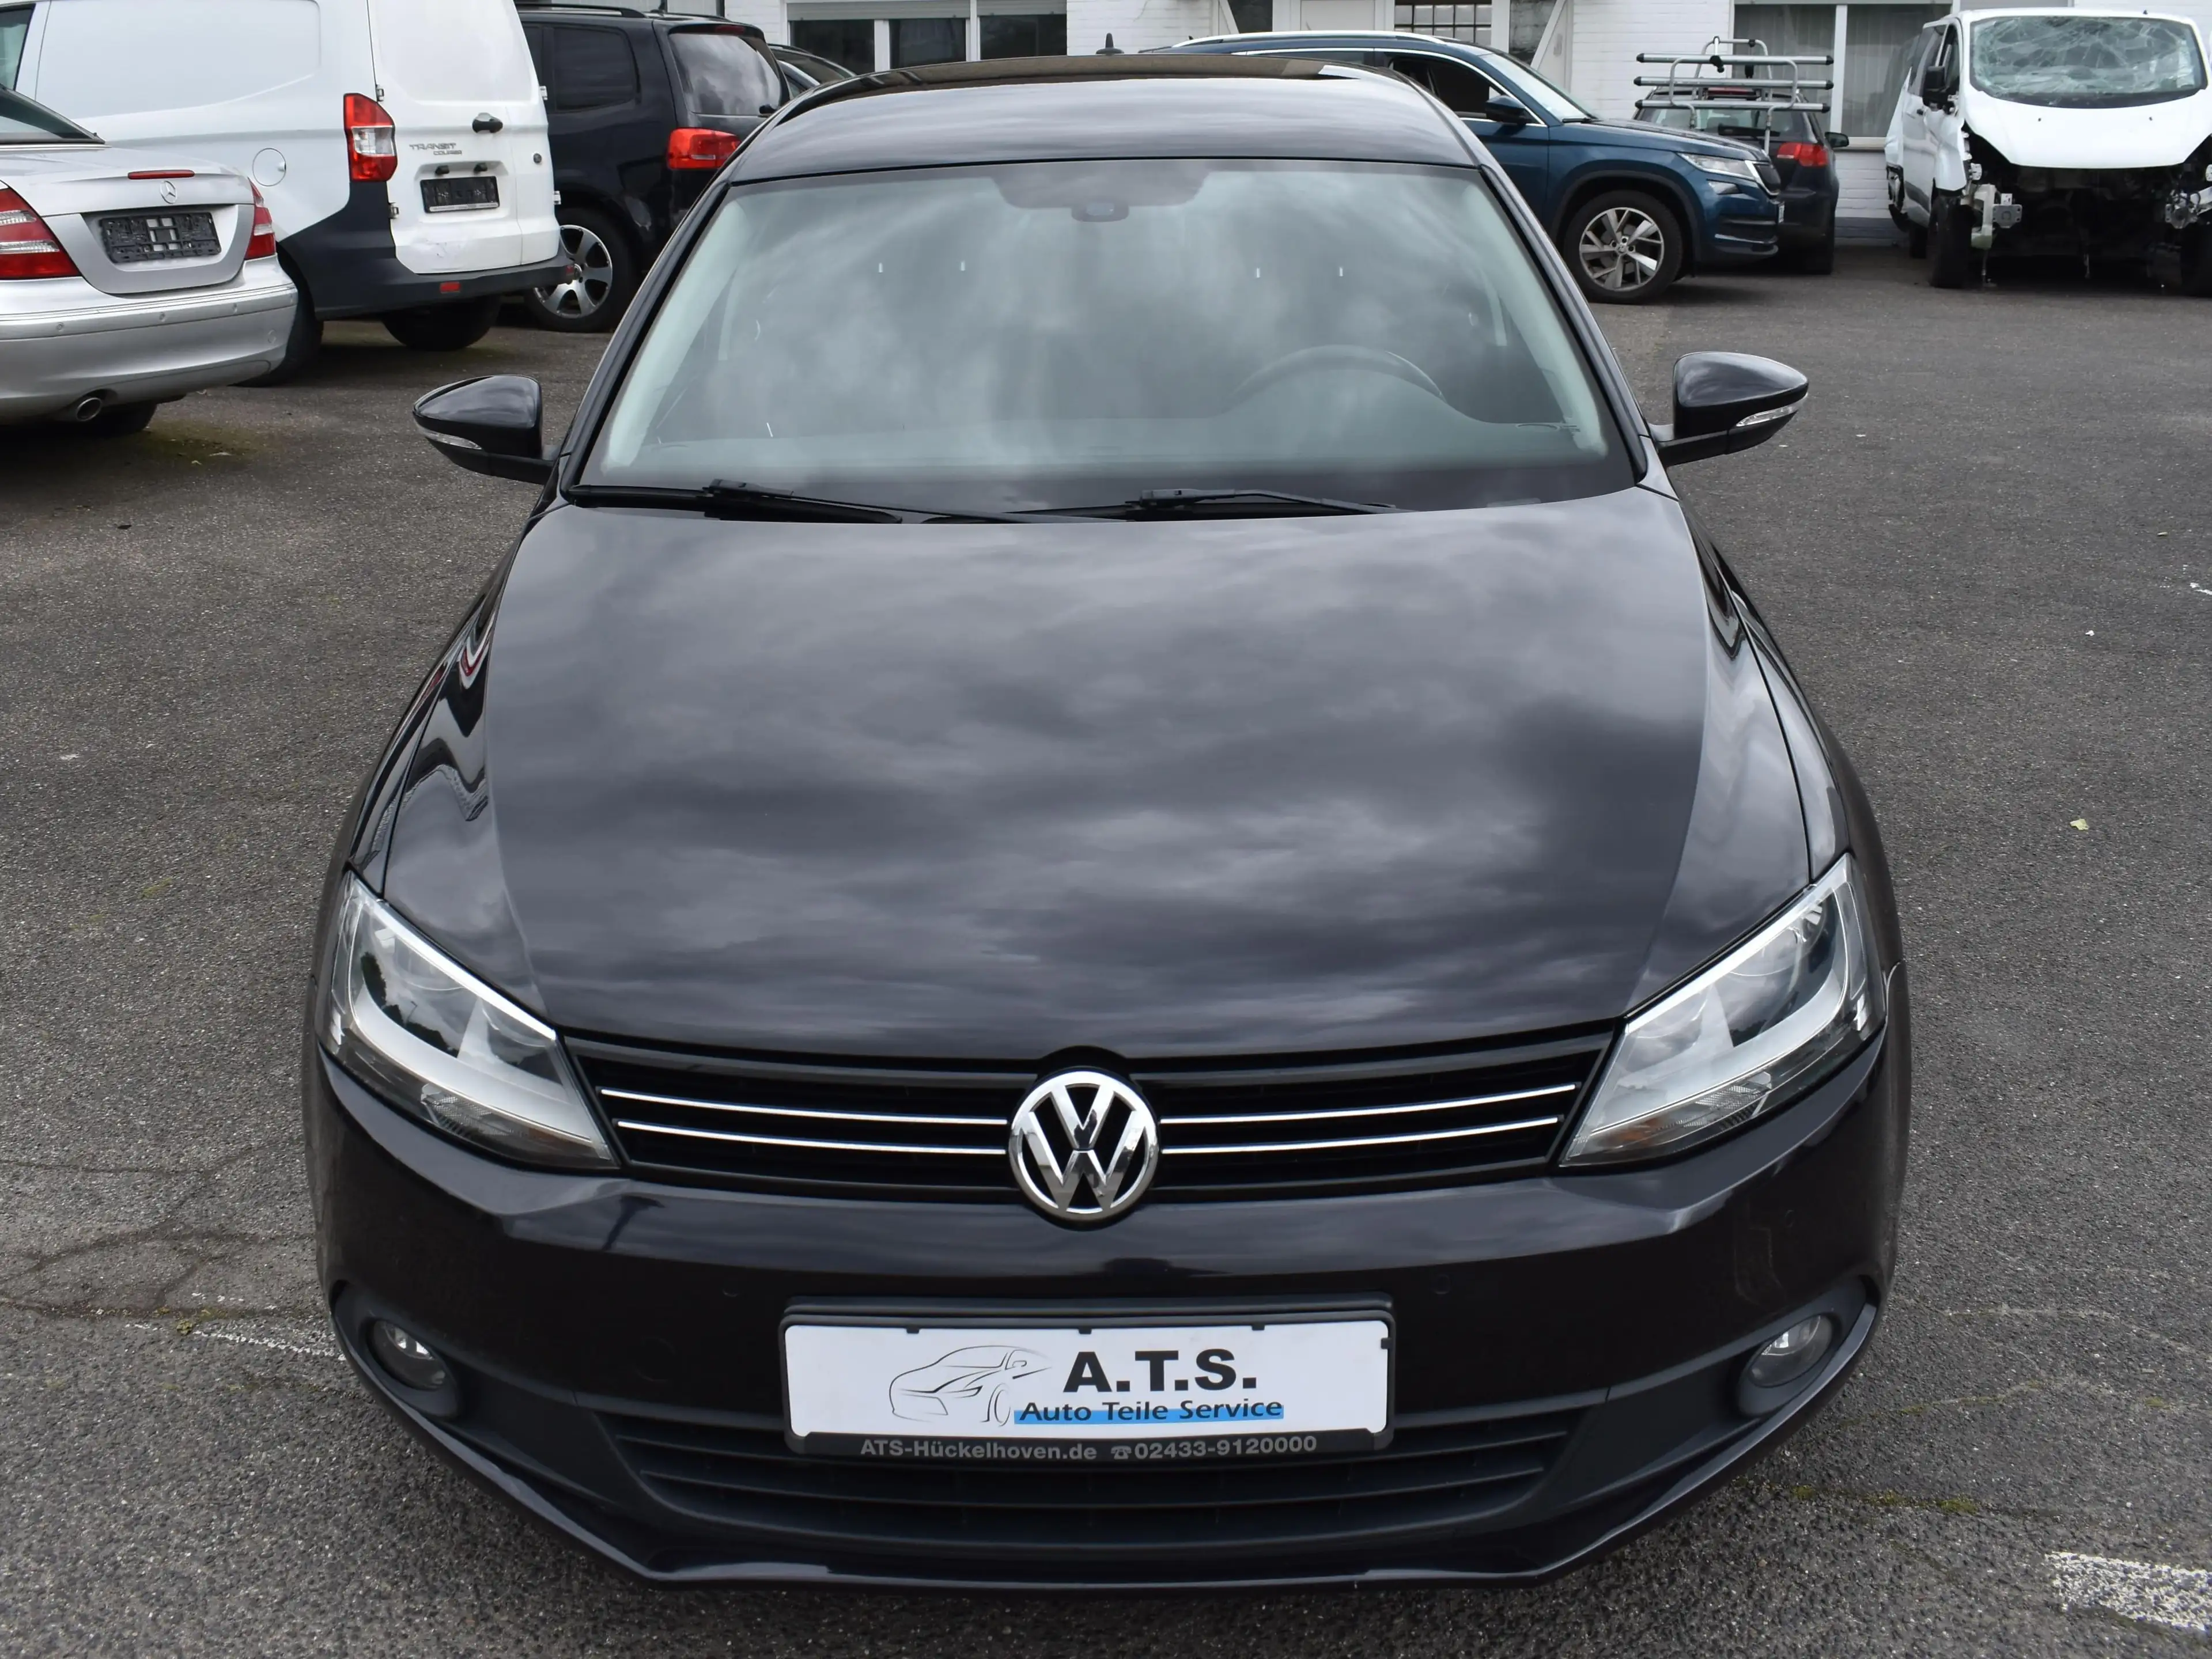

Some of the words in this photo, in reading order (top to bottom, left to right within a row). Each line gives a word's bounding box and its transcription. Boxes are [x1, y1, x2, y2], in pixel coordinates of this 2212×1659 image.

[1063, 1349, 1257, 1392] A.T.S.
[1019, 1402, 1092, 1421] Auto
[1102, 1401, 1169, 1421] Teile
[1179, 1399, 1283, 1419] Service
[861, 1440, 1098, 1460] ATS-Hückelhoven.de
[1134, 1435, 1317, 1459] 02433-9120000
